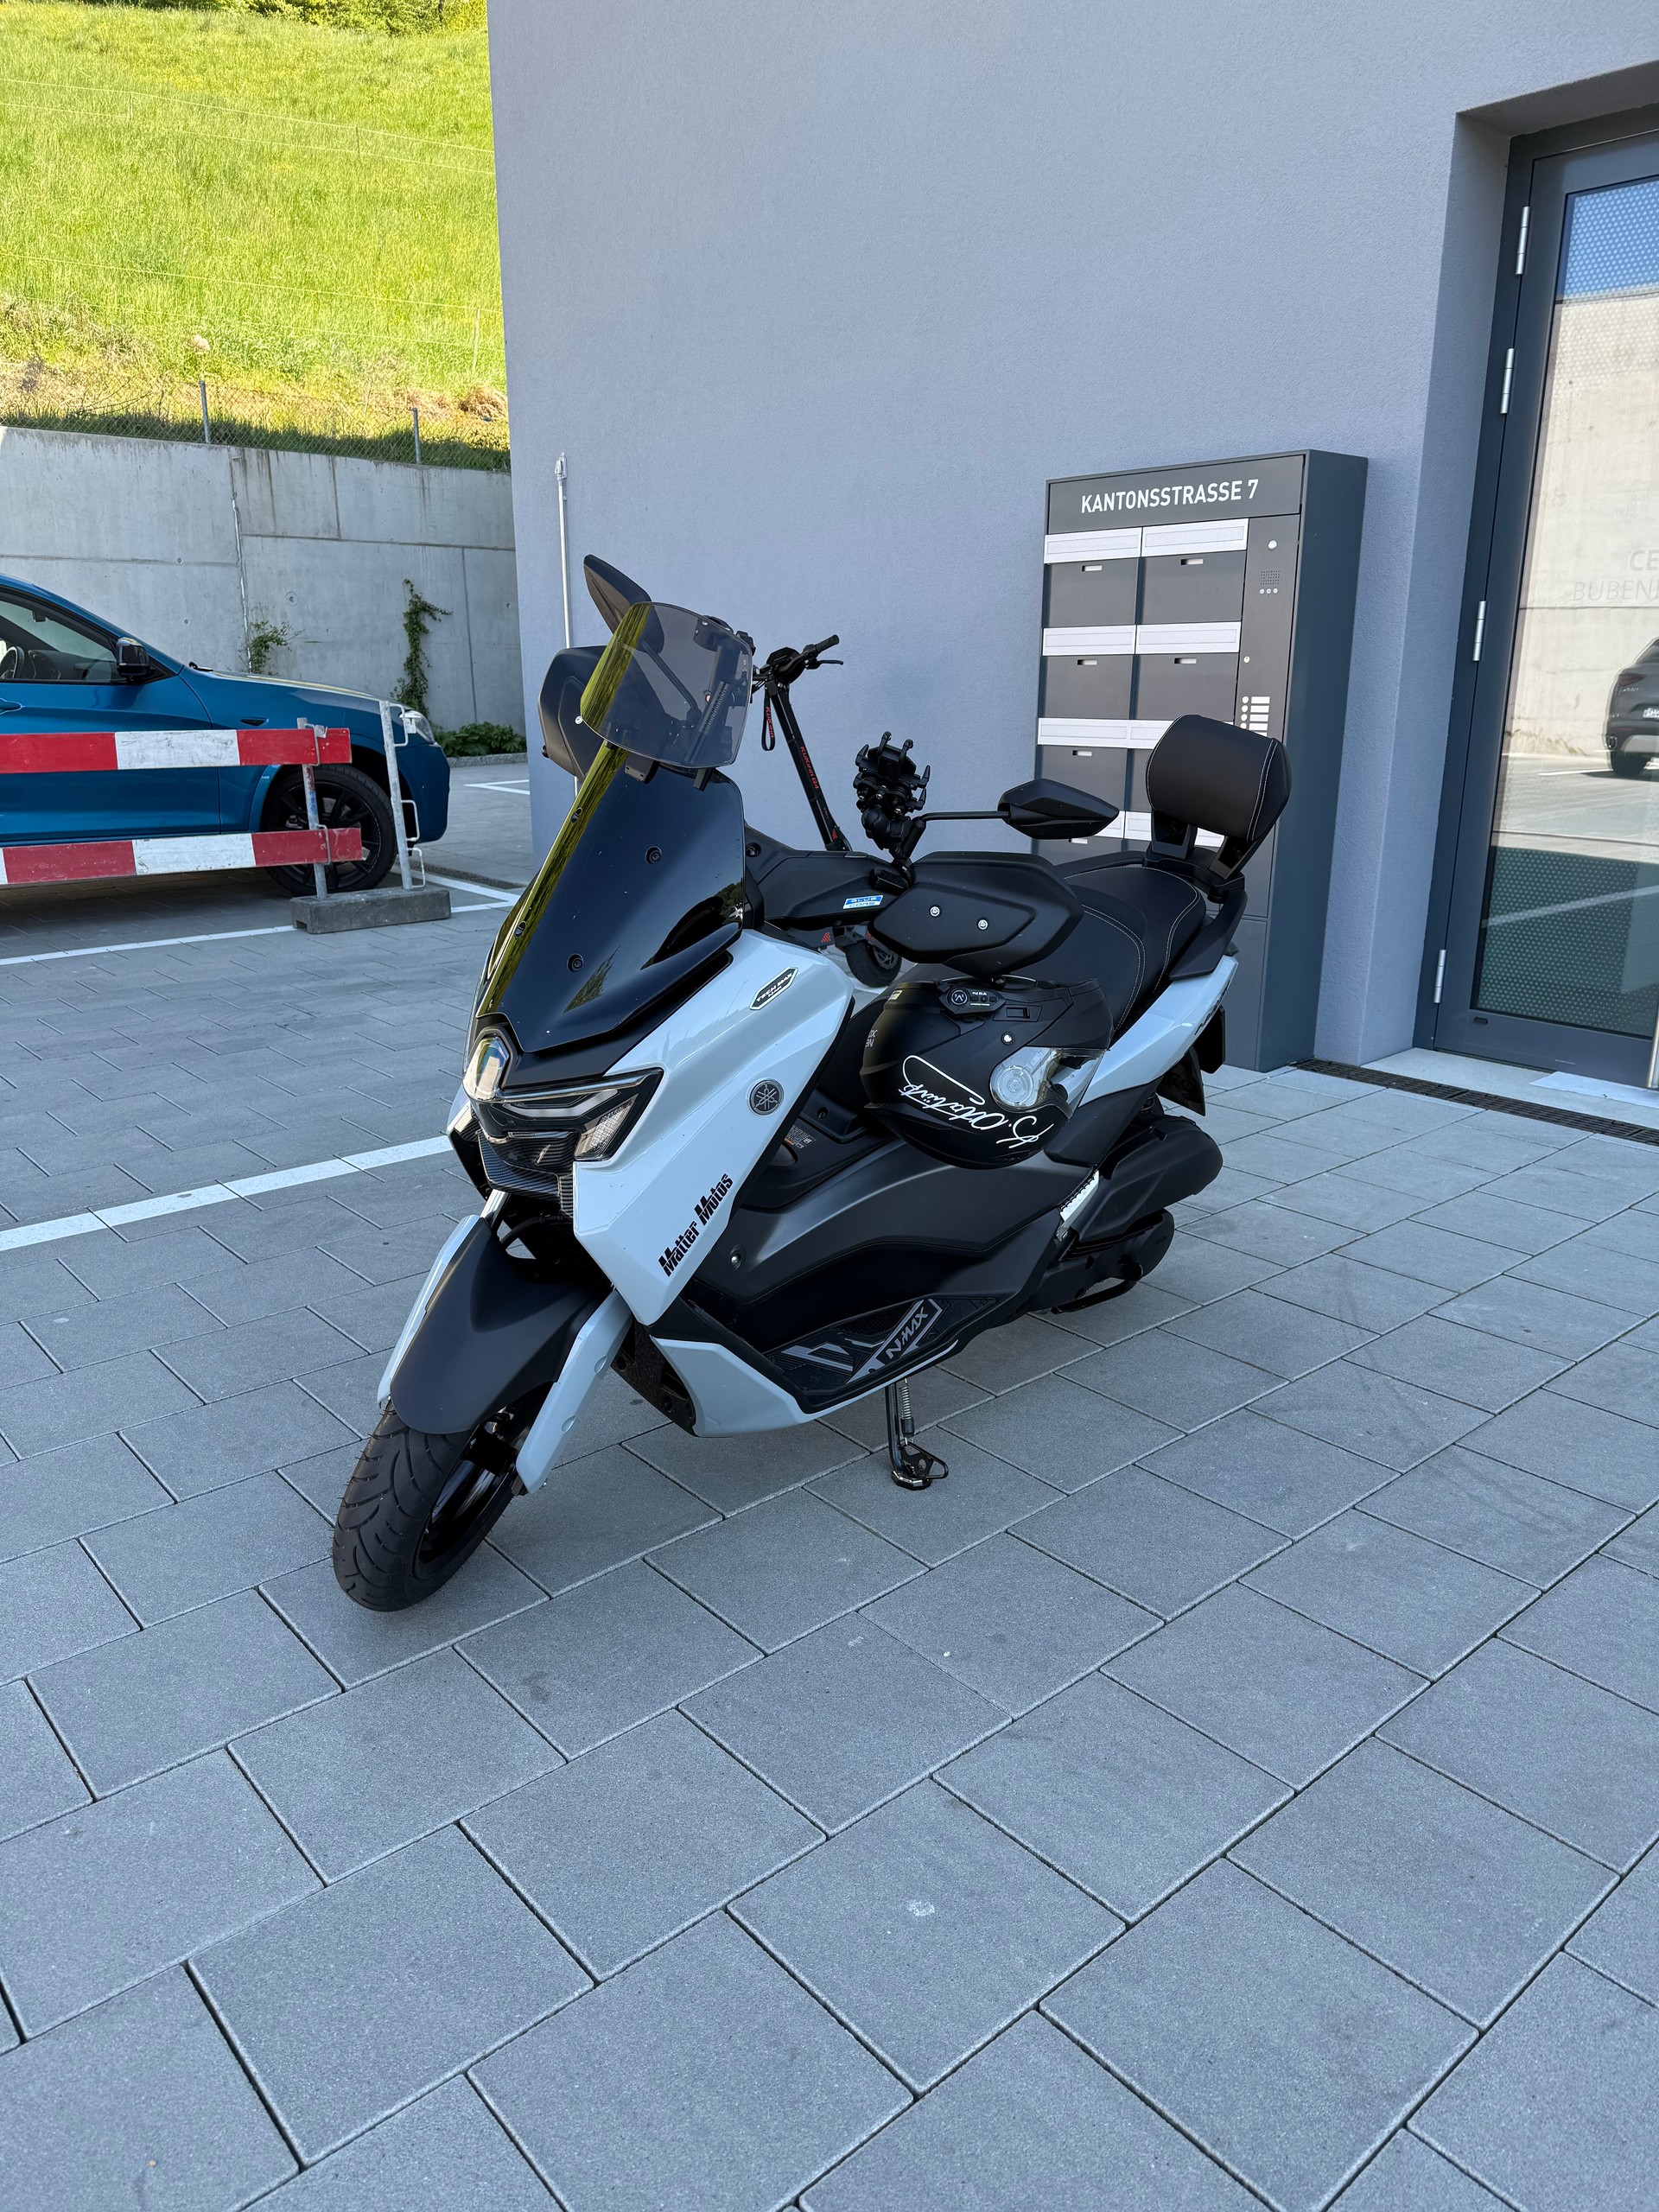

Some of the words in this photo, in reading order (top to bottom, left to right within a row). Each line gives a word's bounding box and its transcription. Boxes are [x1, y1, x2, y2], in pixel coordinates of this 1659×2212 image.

[1081, 480, 1242, 513] KANTONSSTRASSE
[1248, 478, 1259, 499] 7
[1573, 579, 1659, 601] BUBEN
[658, 1220, 701, 1277] Matter
[693, 1173, 734, 1226] Motos
[885, 1306, 929, 1360] NMAX
